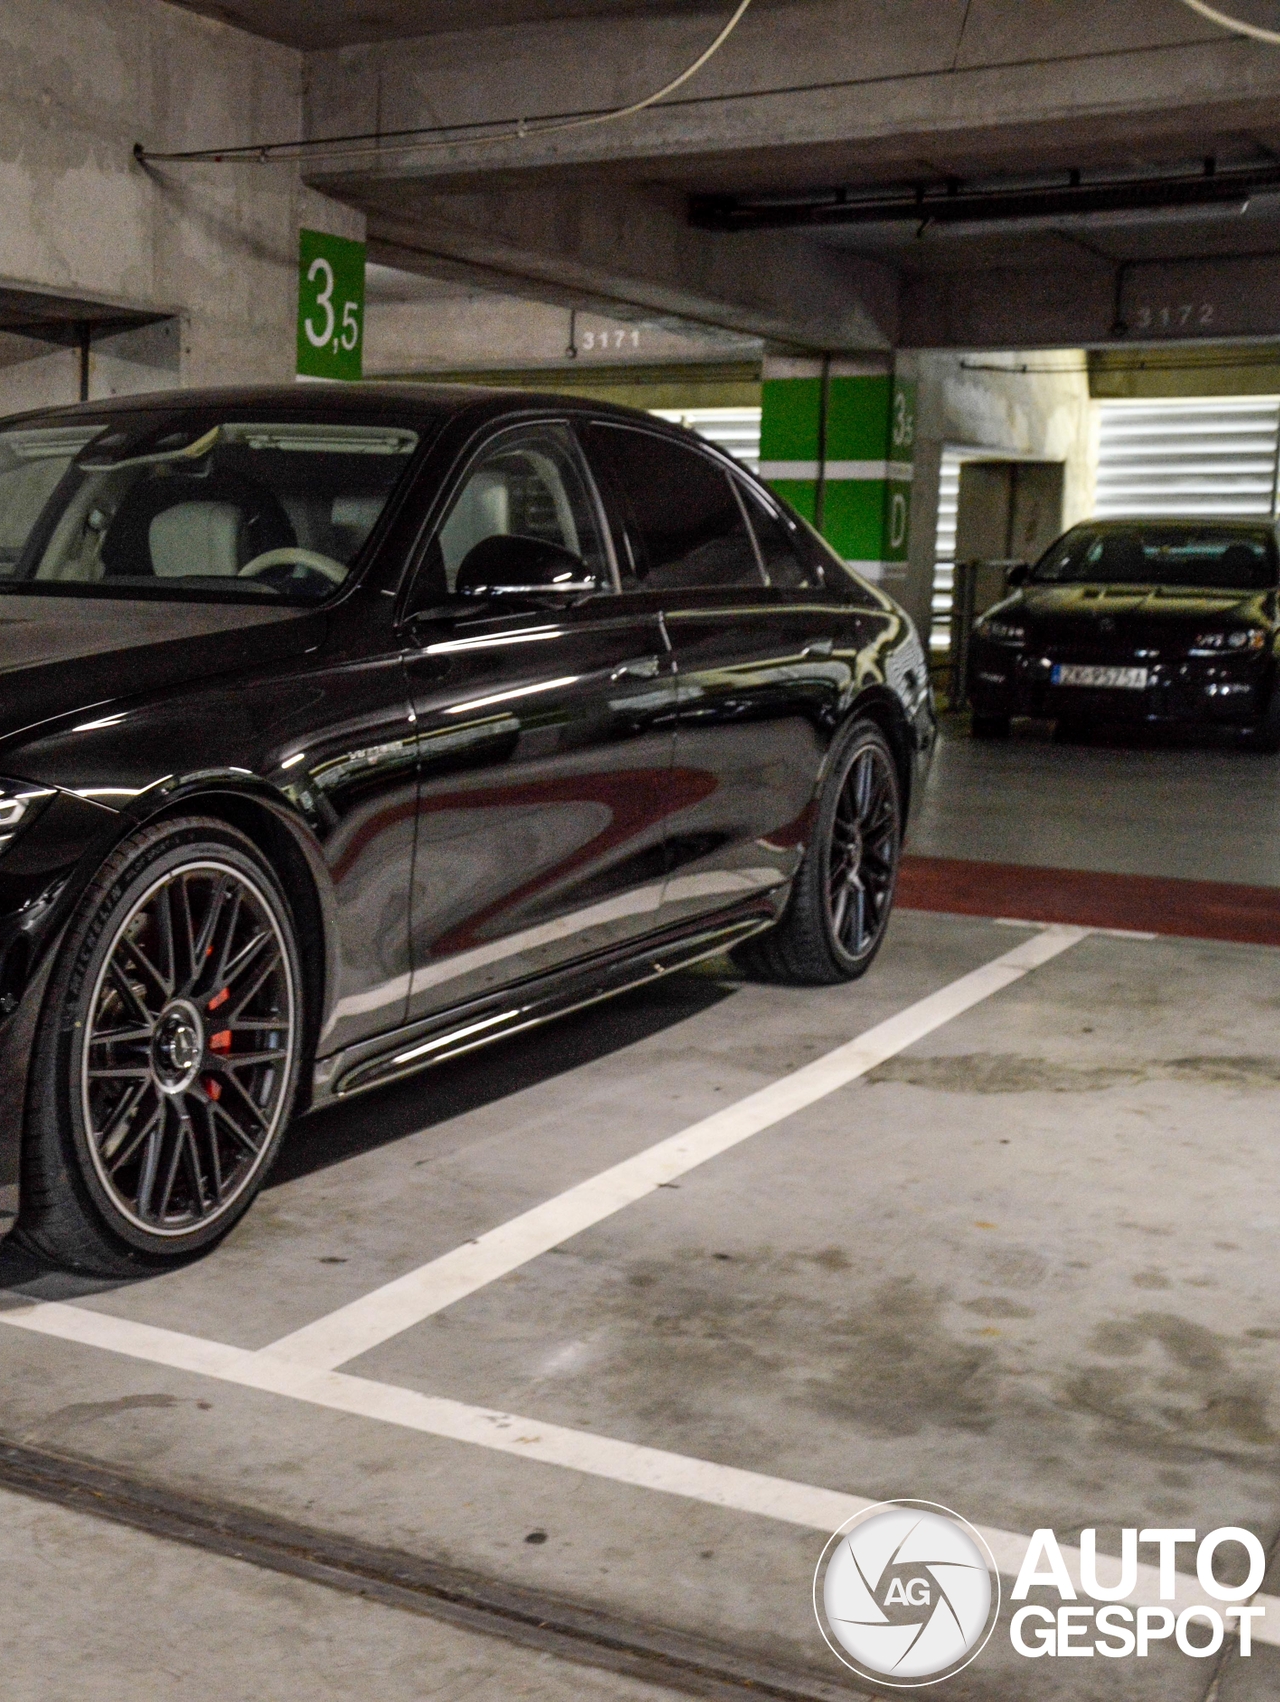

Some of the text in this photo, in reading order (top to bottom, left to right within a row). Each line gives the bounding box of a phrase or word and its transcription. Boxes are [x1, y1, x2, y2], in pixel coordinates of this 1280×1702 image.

[304, 257, 359, 355] 3,5
[1137, 303, 1214, 328] 3172
[582, 329, 640, 350] 3171
